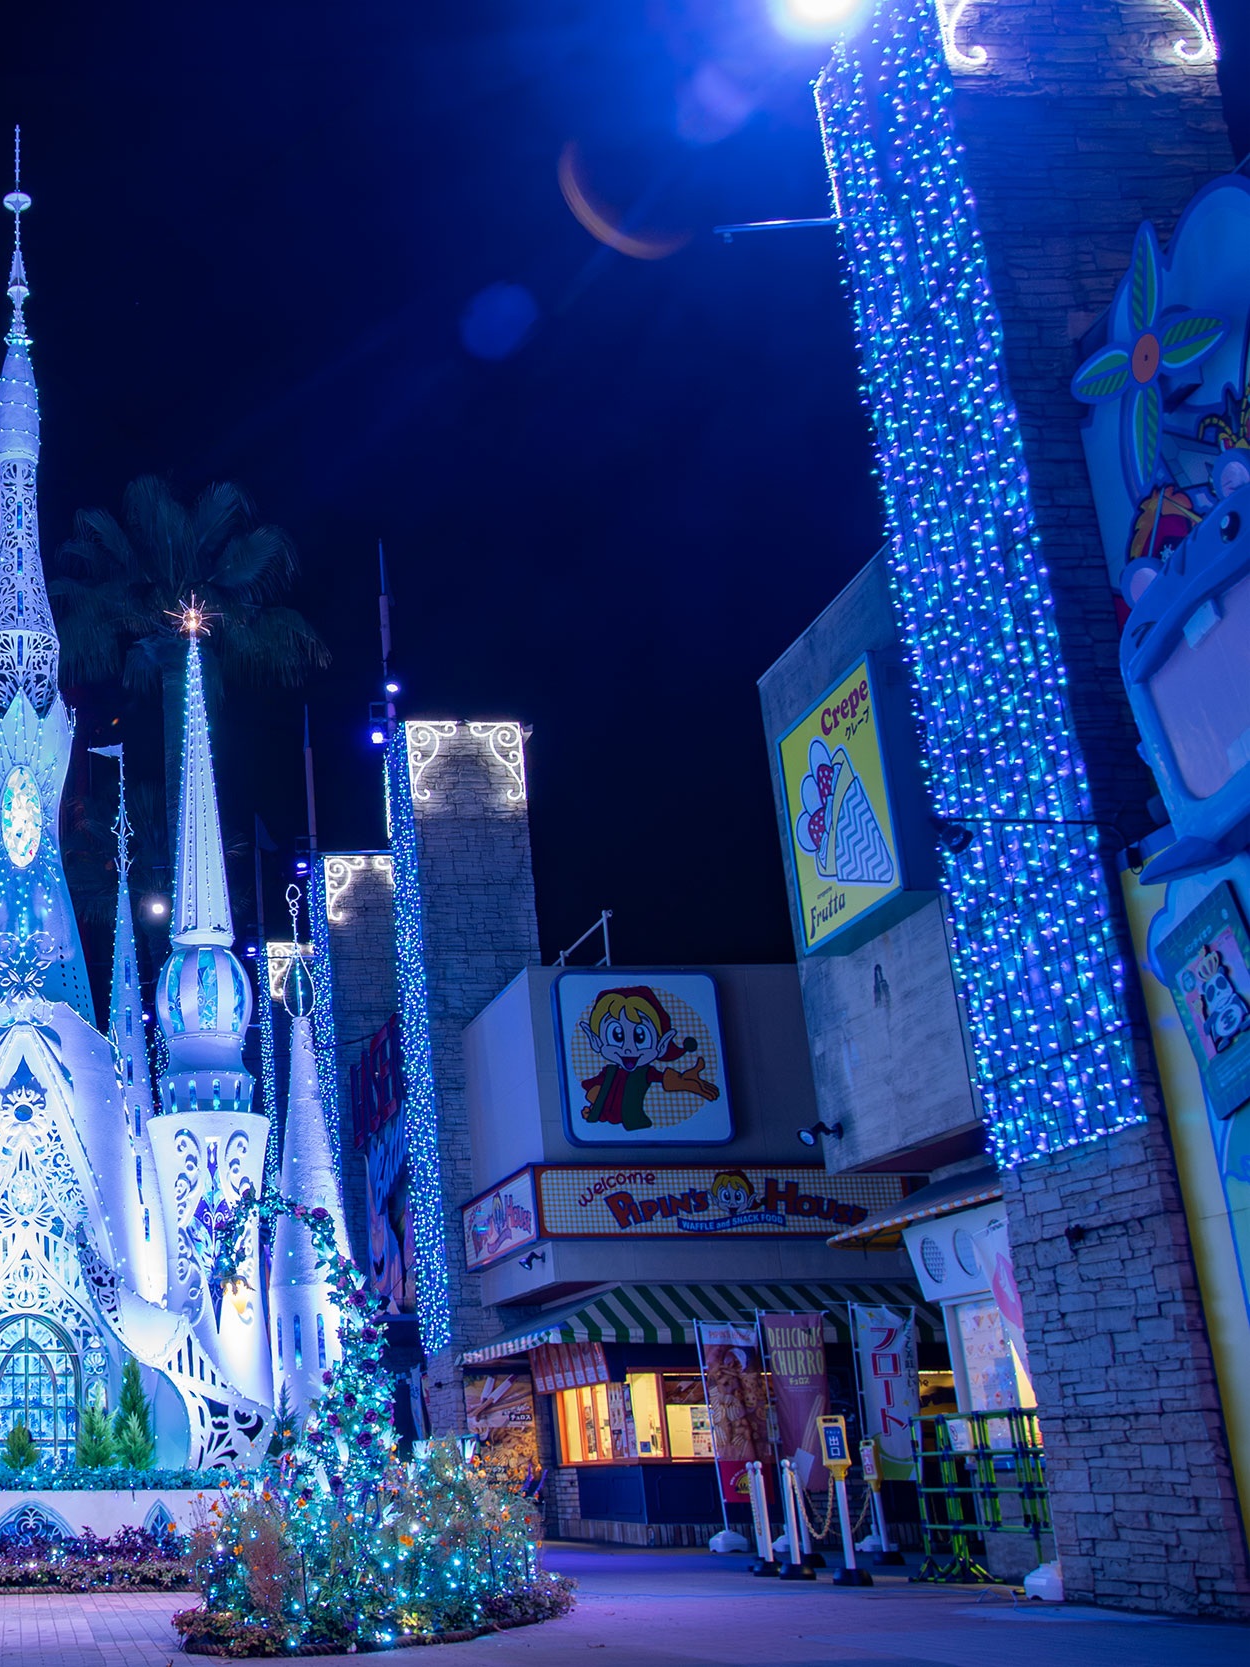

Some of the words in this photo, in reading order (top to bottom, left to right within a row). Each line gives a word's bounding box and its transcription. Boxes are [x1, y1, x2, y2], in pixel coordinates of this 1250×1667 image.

[821, 680, 869, 736] Crepe
[845, 705, 870, 741] クレープ
[810, 891, 846, 940] Frutta
[764, 1177, 869, 1227] HOUSE
[681, 1219, 715, 1231] WAFFLE
[716, 1219, 731, 1230] and
[732, 1213, 760, 1226] SNACK
[760, 1212, 784, 1225] FOOD
[767, 1326, 824, 1348] DELICIOUS
[770, 1349, 825, 1377] CHURRO
[869, 1327, 908, 1437] フロート
[828, 1436, 841, 1457] 出口
